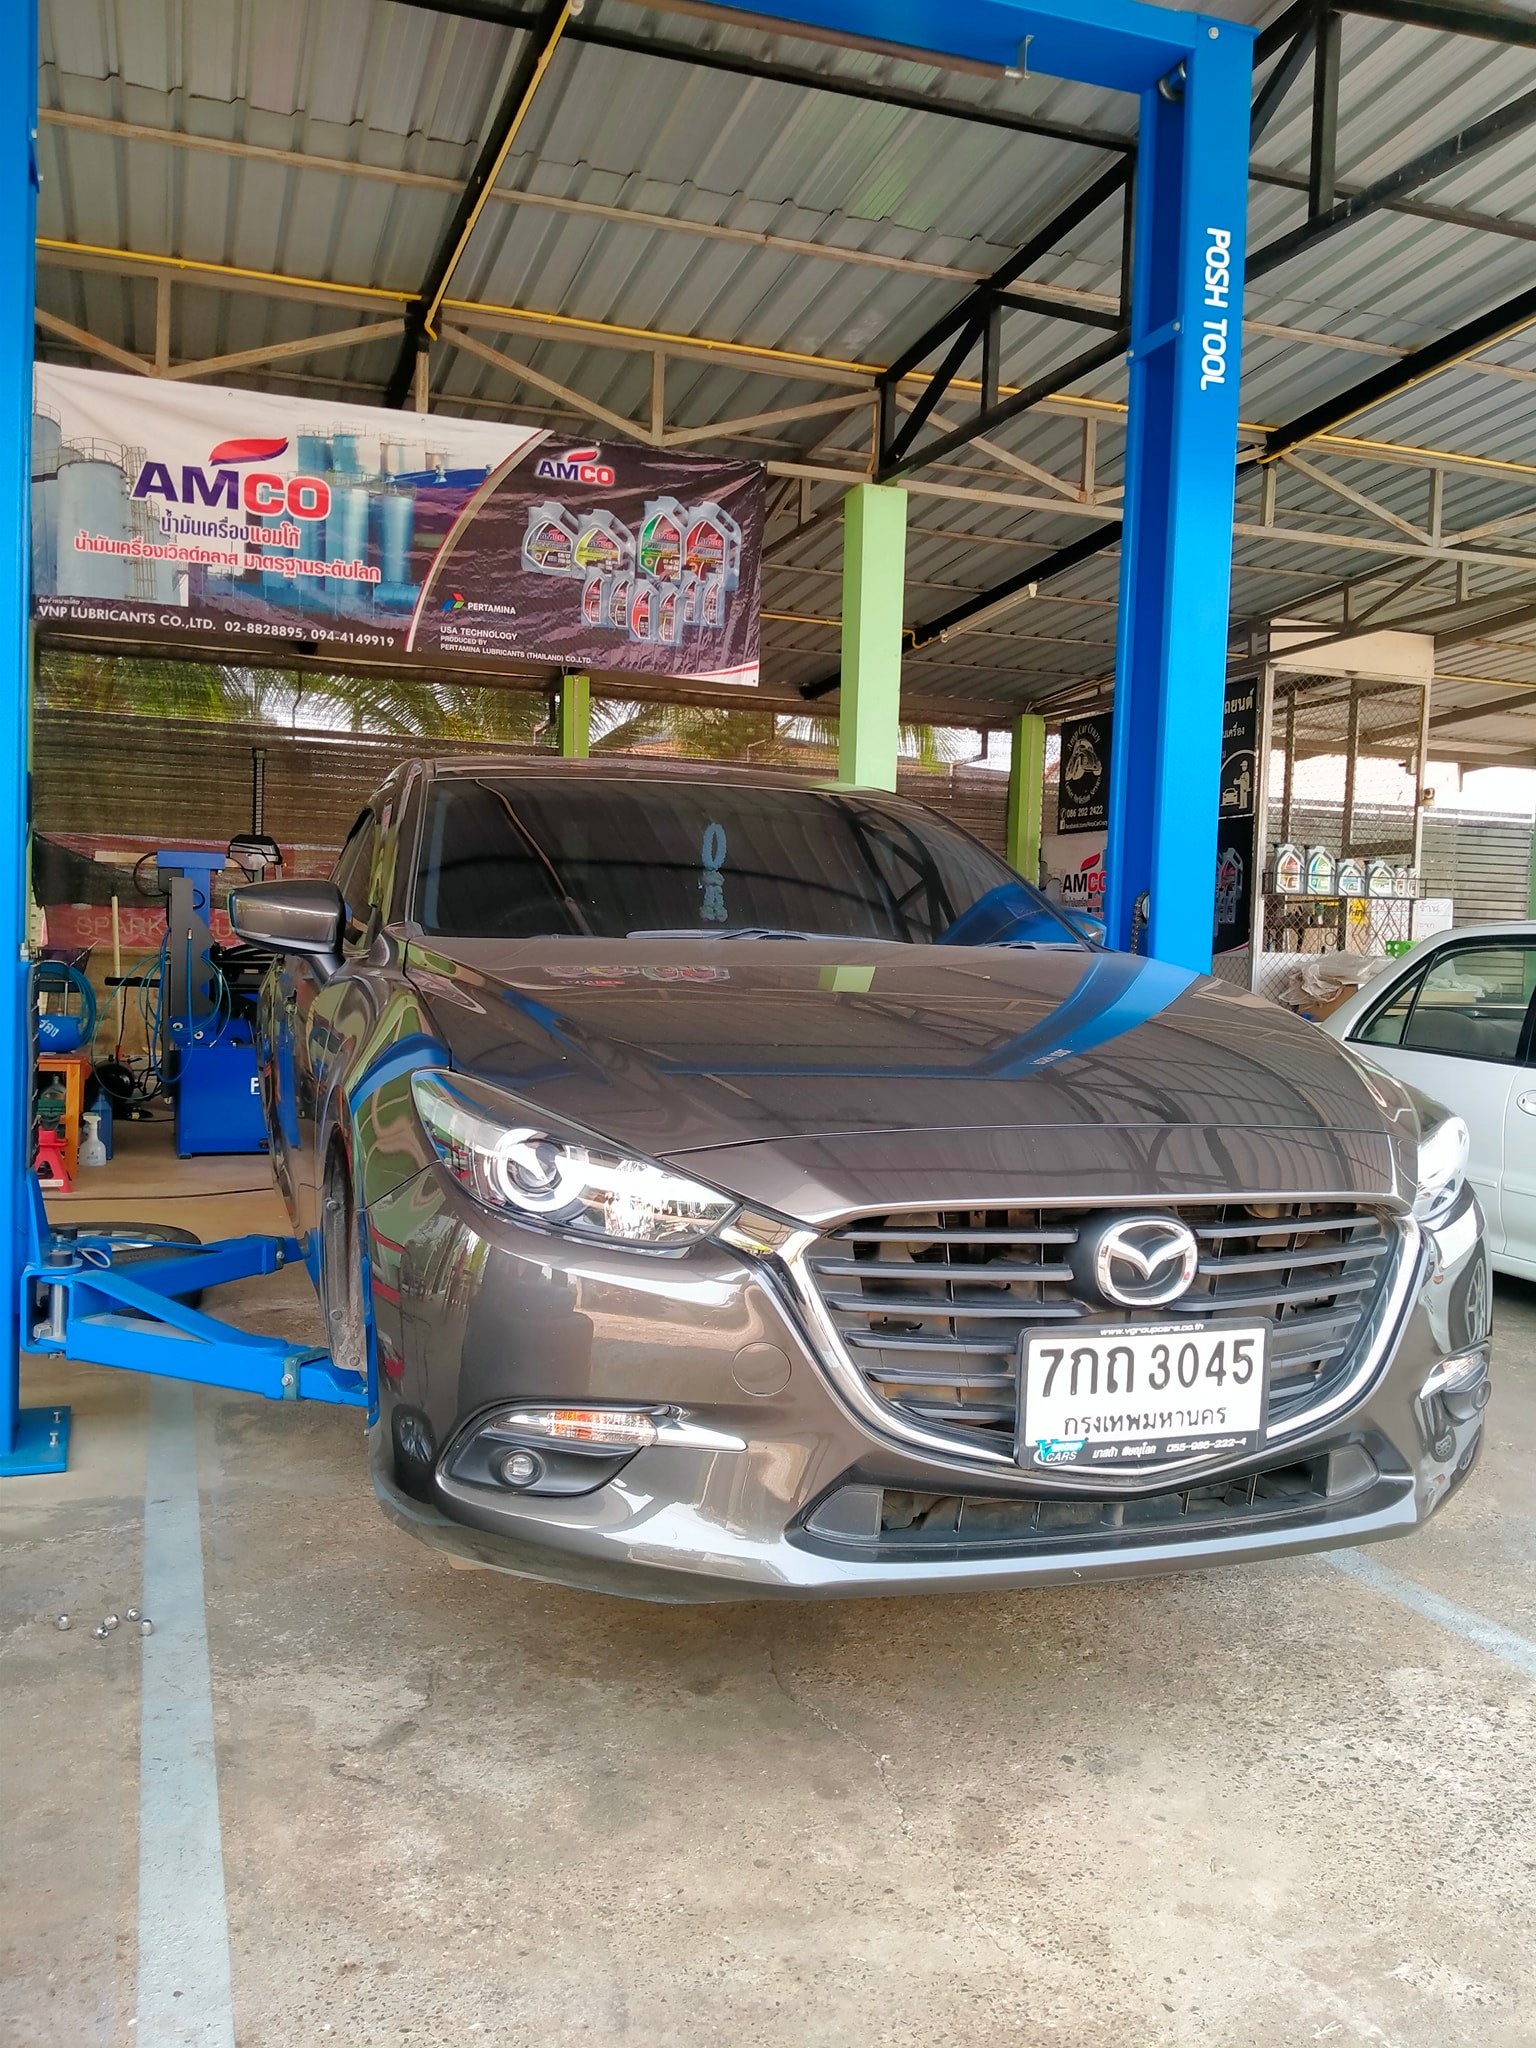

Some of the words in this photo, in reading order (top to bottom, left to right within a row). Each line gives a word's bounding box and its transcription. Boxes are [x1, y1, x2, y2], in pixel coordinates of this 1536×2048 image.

[1204, 227, 1231, 308] POSH
[1200, 318, 1228, 391] TOOL
[538, 461, 614, 486] AMCO
[131, 461, 330, 520] AMCO
[243, 553, 380, 581] มาตรฐานระดับโลก
[468, 602, 516, 614] PERTAMINA
[39, 606, 67, 618] VNP
[71, 607, 156, 625] LUBRICANTS
[160, 614, 216, 630] CO.,LTD.
[311, 629, 394, 647] 094-4149919
[440, 626, 458, 635] USA
[461, 627, 517, 641] TECHNOLOGY
[440, 636, 476, 645] PRODUCED
[478, 638, 487, 646] BY
[440, 644, 480, 654] PERTAMINA
[482, 647, 525, 658] LUBRICANTS
[526, 652, 564, 662] (THAILAND)
[76, 916, 164, 936] SPARK
[1040, 1346, 1135, 1397] 7กถ
[1149, 1338, 1255, 1390] 3045
[1064, 1406, 1227, 1441] กรุงเทพมหานคร
[1046, 1451, 1077, 1462] CARS
